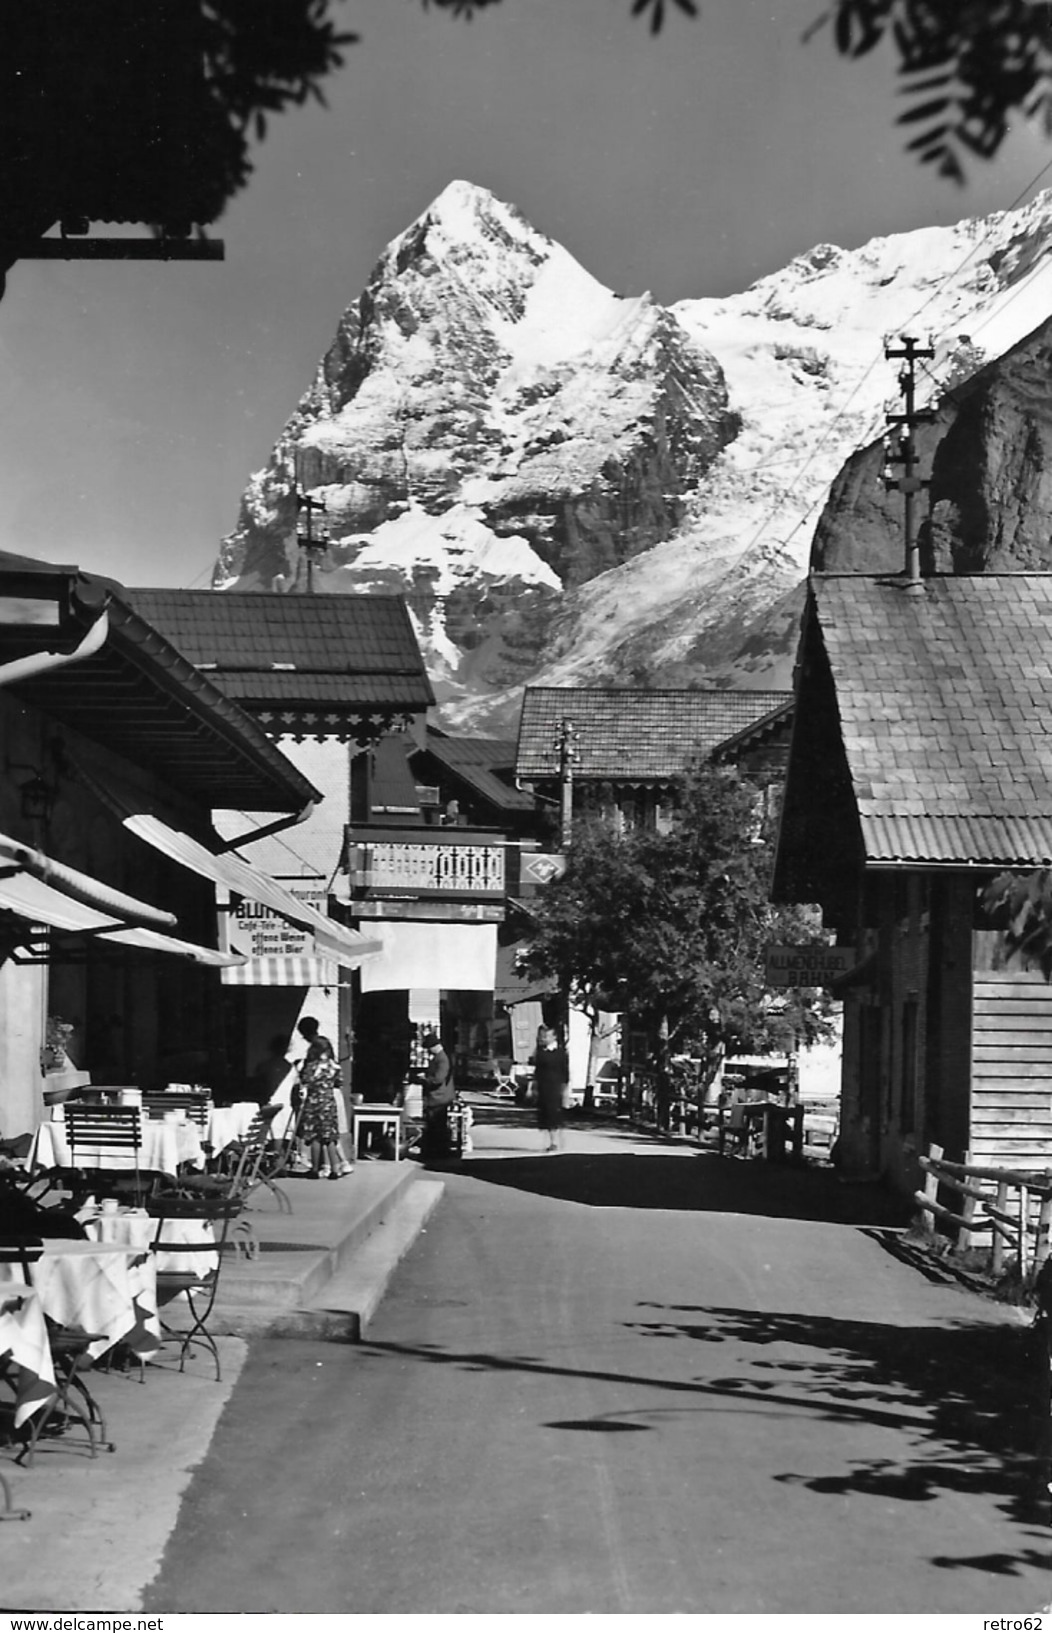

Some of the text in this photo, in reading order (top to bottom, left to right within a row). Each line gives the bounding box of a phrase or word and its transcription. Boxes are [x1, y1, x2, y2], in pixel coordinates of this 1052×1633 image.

[289, 887, 328, 900] taurant
[252, 932, 278, 944] offene
[252, 944, 304, 956] offenes Bier
